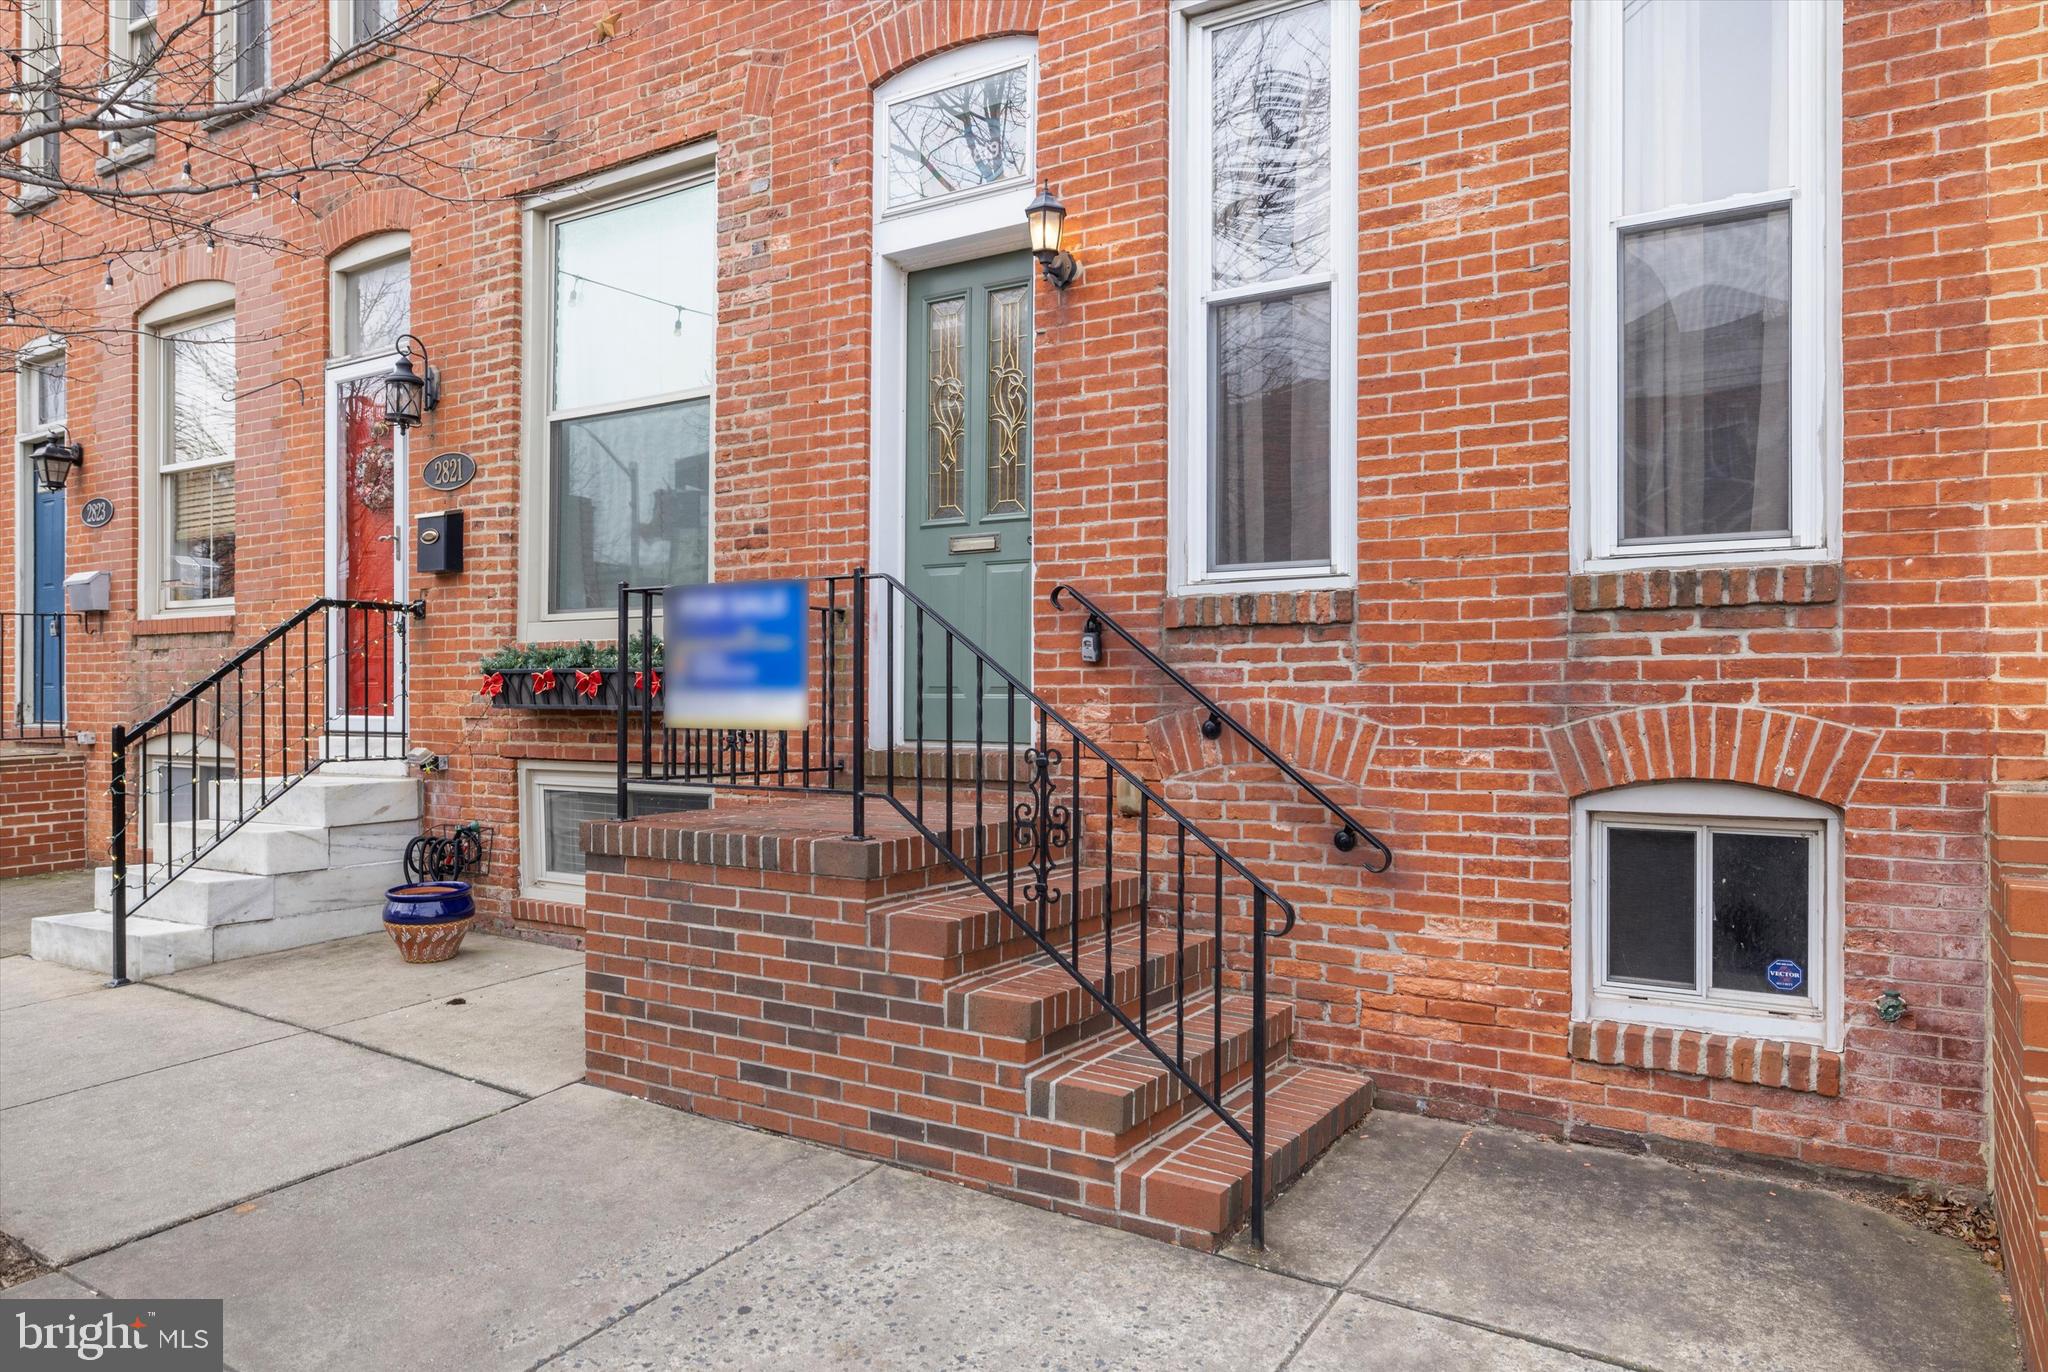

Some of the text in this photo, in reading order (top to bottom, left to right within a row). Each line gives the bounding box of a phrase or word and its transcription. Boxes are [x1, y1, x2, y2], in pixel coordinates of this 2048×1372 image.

[433, 457, 462, 484] 2821
[86, 502, 106, 522] 2823
[1769, 970, 1800, 978] VECTOR
